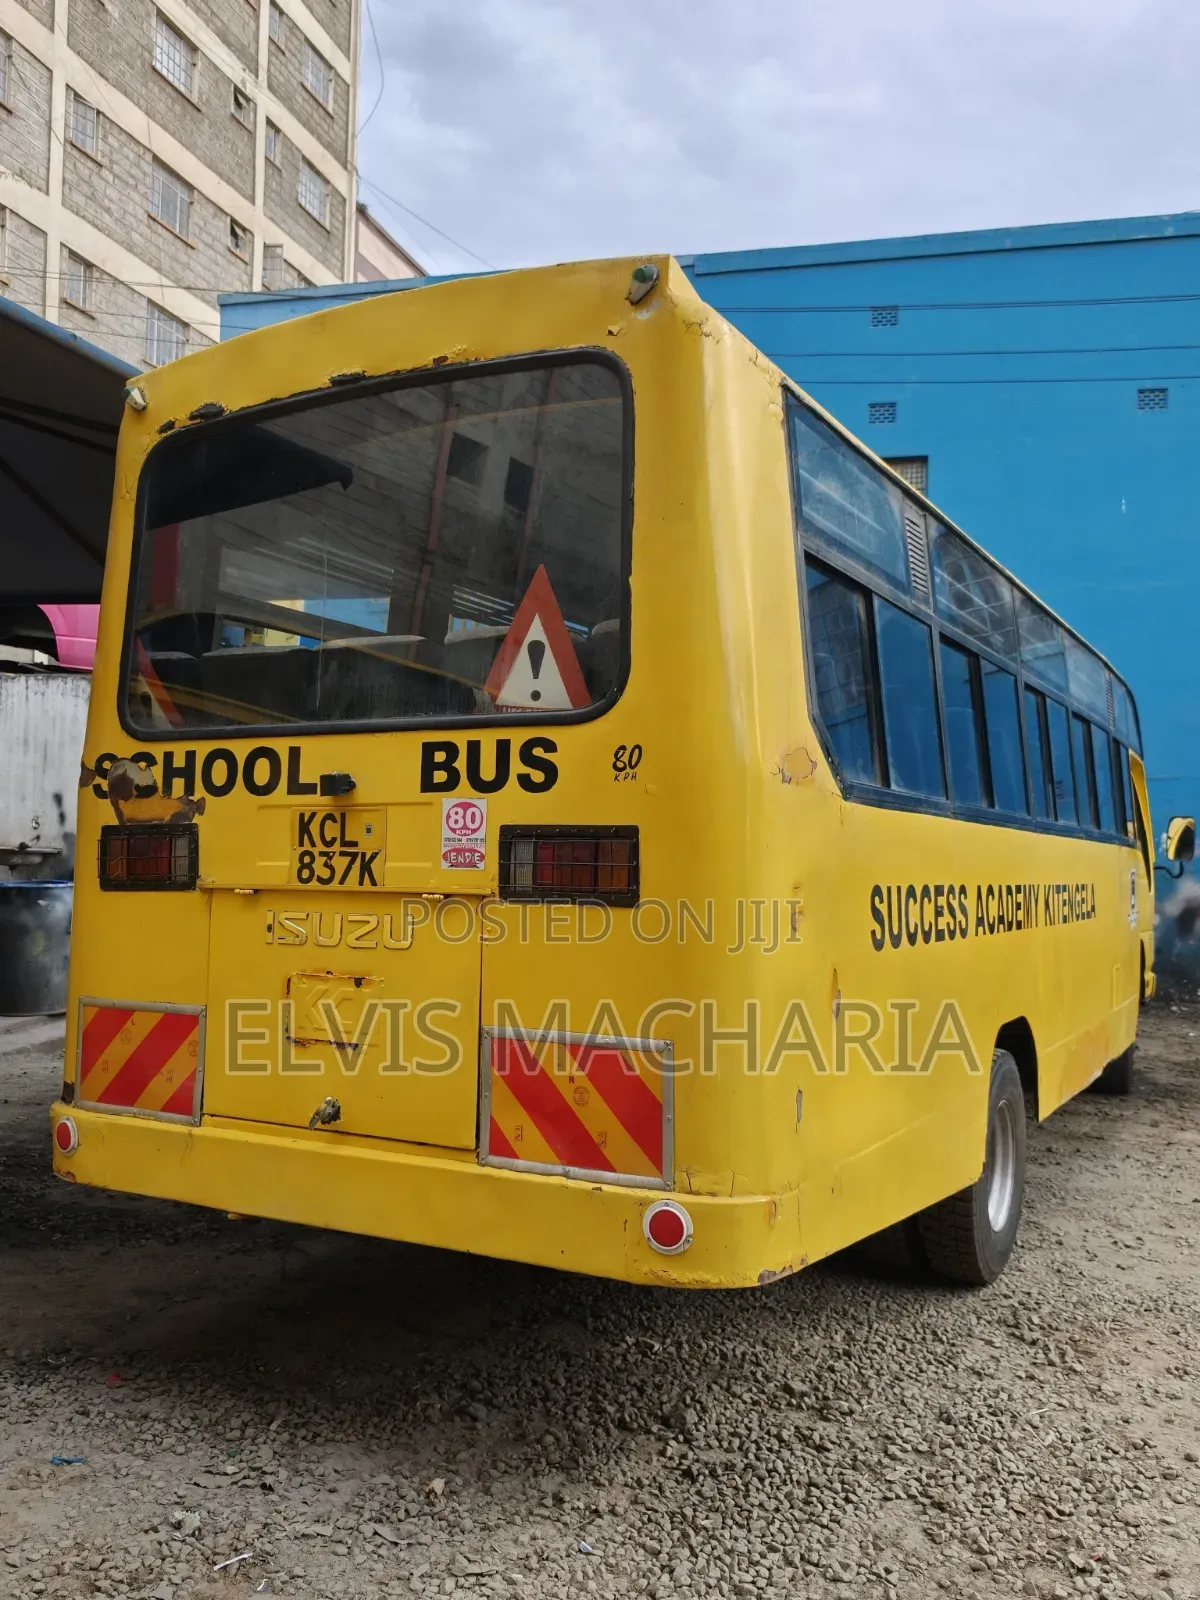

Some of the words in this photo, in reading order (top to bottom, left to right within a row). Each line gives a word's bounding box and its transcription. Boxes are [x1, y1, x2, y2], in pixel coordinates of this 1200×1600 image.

[94, 746, 318, 799] SCHOOL
[420, 737, 559, 794] BUS
[612, 744, 642, 772] 80
[298, 811, 358, 848] KCL
[448, 807, 481, 829] 80
[296, 849, 379, 887] 837K
[265, 910, 414, 950] ISUZU
[870, 884, 969, 952] SUCCESS
[974, 884, 1040, 936] ACADEMY
[1044, 883, 1096, 927] KITENGELA
[568, 1076, 575, 1084] R
